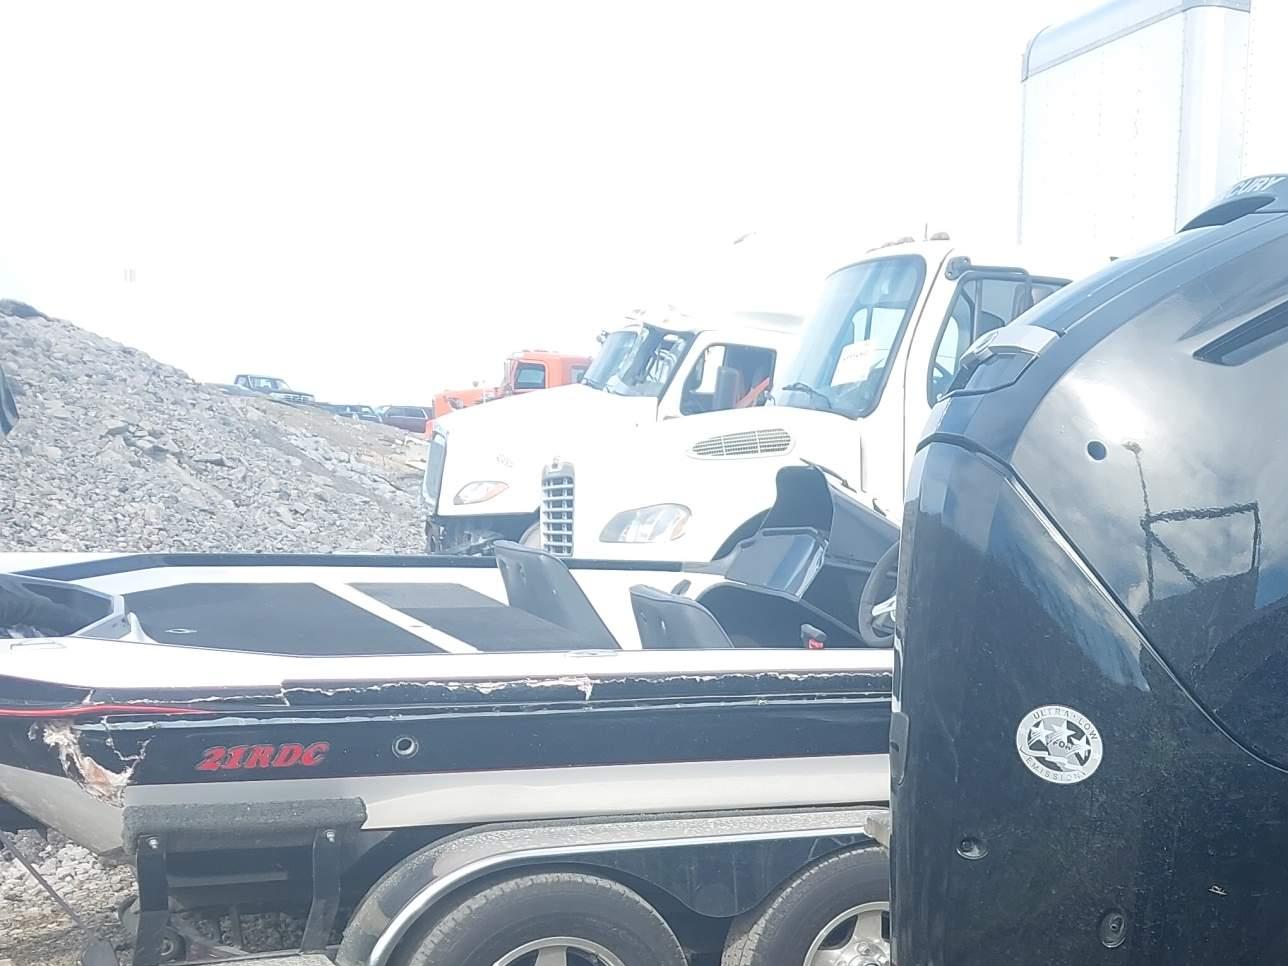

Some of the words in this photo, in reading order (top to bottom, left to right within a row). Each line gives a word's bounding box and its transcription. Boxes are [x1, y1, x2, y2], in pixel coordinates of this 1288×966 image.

[1033, 707, 1070, 720] ULTRA
[1078, 717, 1099, 741] LOW
[195, 741, 330, 771] 21RDC
